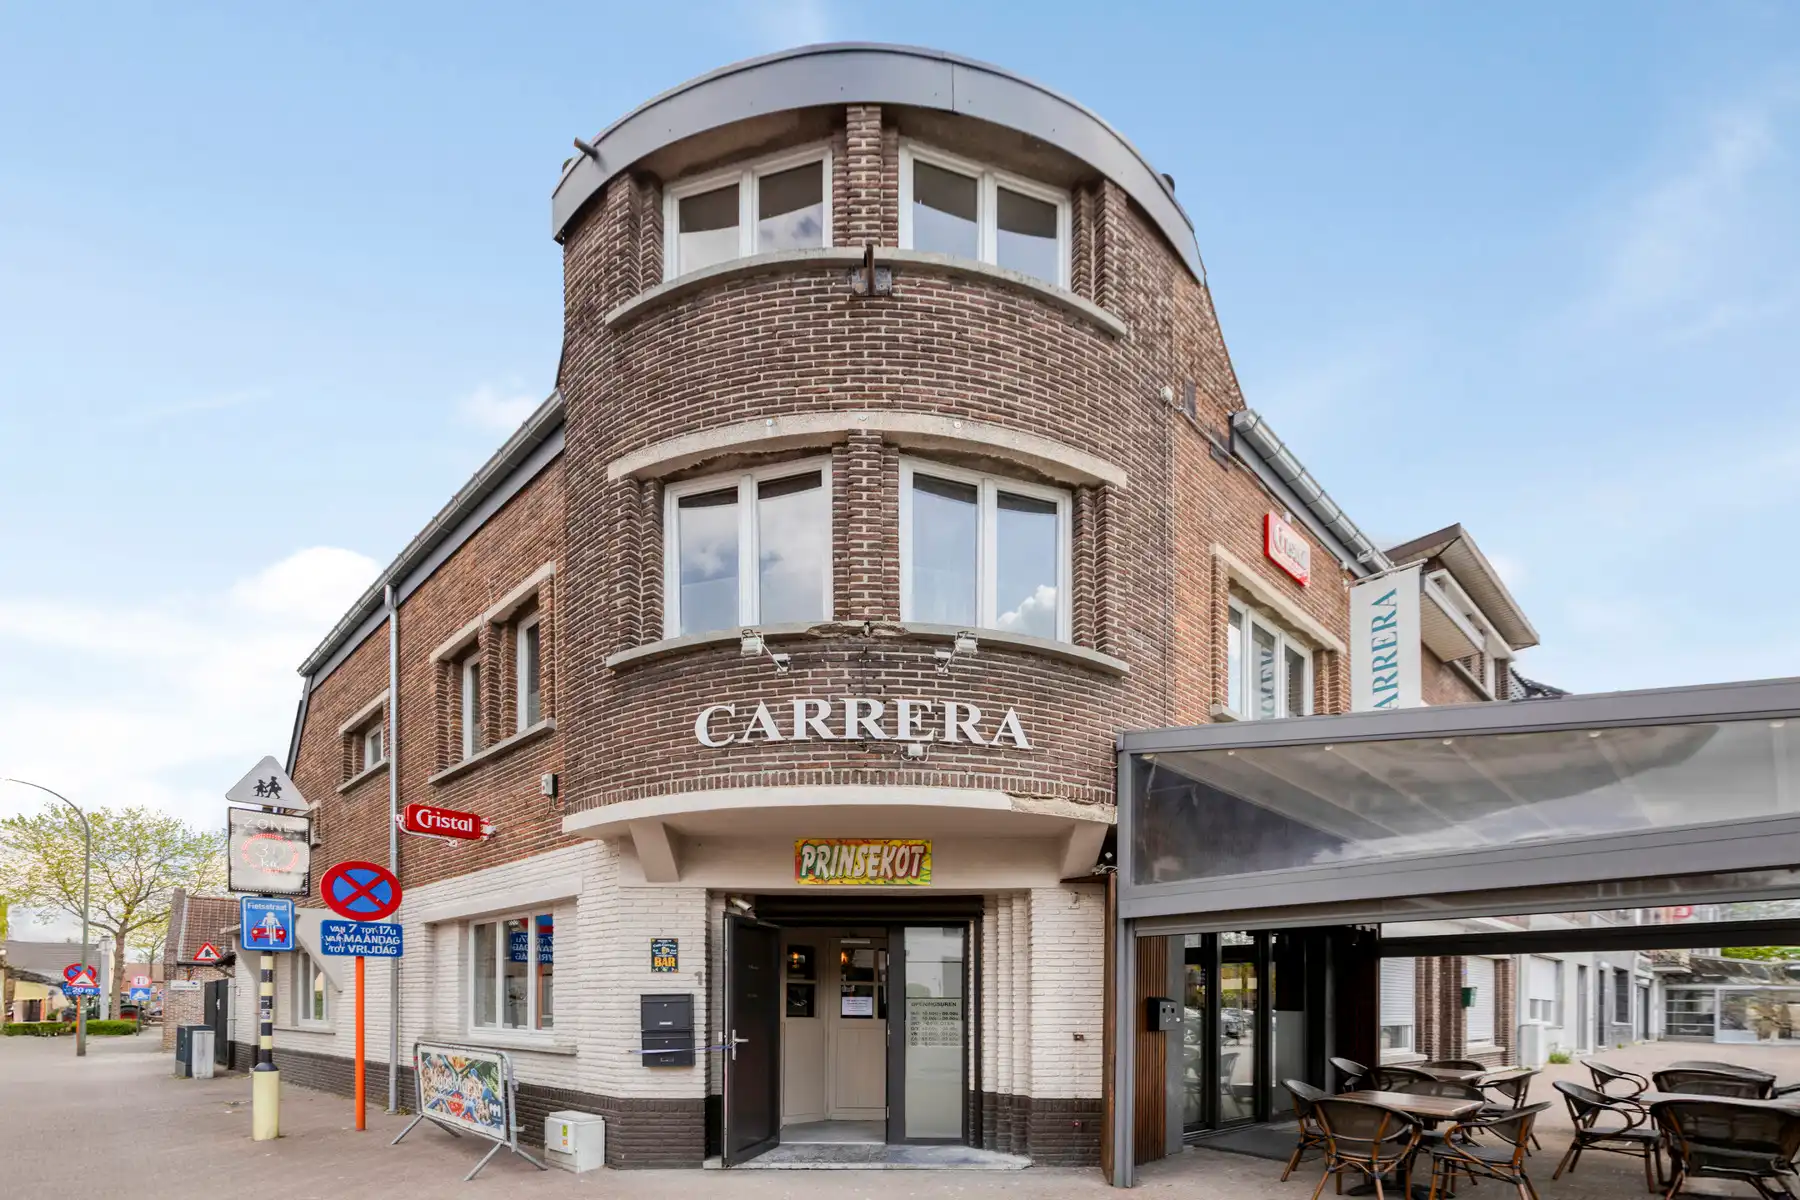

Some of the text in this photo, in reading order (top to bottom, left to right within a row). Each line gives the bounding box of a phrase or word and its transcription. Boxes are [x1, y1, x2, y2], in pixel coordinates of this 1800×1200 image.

[1371, 588, 1399, 710] ARRERA
[694, 698, 1033, 750] CARRERA
[415, 809, 473, 832] Cristal
[799, 843, 926, 880] PRINSEKOT
[329, 925, 346, 933] VAN
[348, 924, 358, 933] 7
[344, 934, 401, 944] MAANDAG
[347, 945, 397, 955] VRIJDAG
[654, 956, 676, 967] BAR
[694, 971, 703, 985] 1
